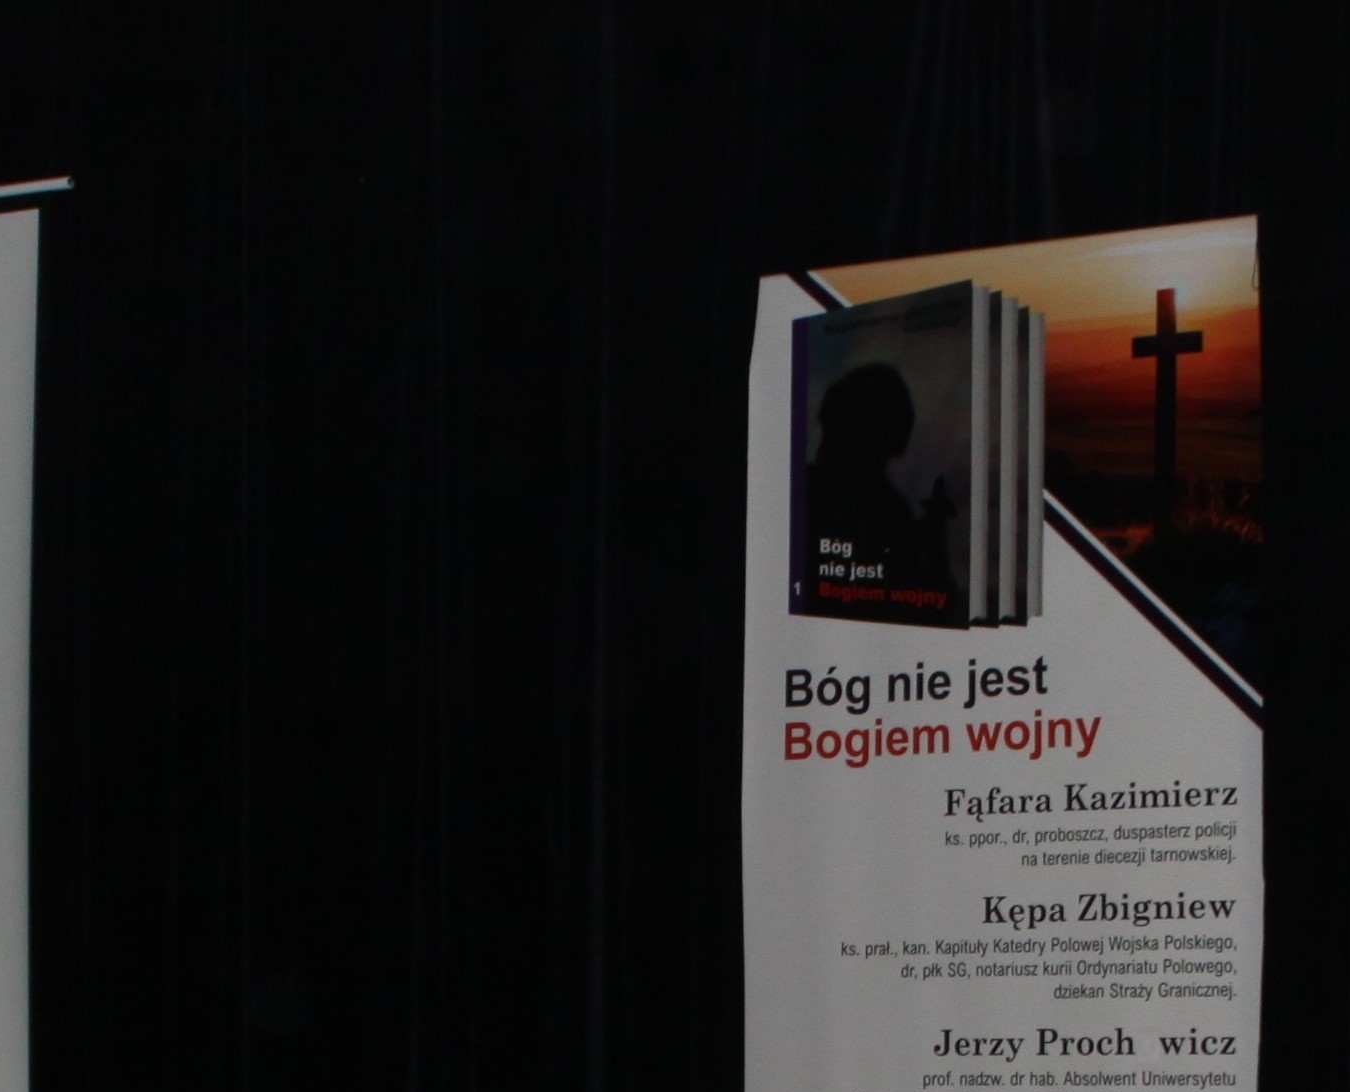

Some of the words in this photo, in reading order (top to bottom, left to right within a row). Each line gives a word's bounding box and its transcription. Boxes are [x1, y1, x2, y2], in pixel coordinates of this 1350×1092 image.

[819, 538, 852, 558] Bóg
[819, 561, 845, 576] nie
[849, 562, 884, 581] jest
[793, 581, 801, 595] 1
[784, 666, 872, 715] Bóg
[887, 662, 951, 702] nie
[964, 656, 1048, 709] jest
[783, 718, 950, 768] Bogiem
[966, 709, 1102, 760] wojny
[943, 787, 1053, 822] Fąfara
[1063, 780, 1238, 812] Kazimierz
[945, 831, 964, 846] ks.
[1034, 828, 1108, 846] proboszcz,
[1114, 825, 1190, 843] duspasterz
[1195, 821, 1236, 840] policji
[1021, 854, 1038, 866] na
[1042, 851, 1090, 865] terenie
[1094, 848, 1146, 867] diecezji
[1150, 846, 1236, 864] tarnowskiej.
[982, 895, 1066, 930] Kępa
[1078, 891, 1237, 927] Zbigniew
[841, 942, 860, 956] ks.
[903, 941, 930, 955] kan.
[935, 939, 988, 957] Kapituły
[993, 939, 1046, 956] Katedry
[1051, 937, 1104, 955] Polowej
[1109, 936, 1159, 954] Wojska
[1164, 935, 1237, 953] Polskiego,
[922, 964, 942, 981] płk
[948, 963, 971, 979] SG,
[976, 962, 1038, 977] notariusz
[1043, 961, 1072, 975] kurii
[1077, 960, 1157, 978] Ordynariatu
[1163, 959, 1237, 977] Polowego,
[1054, 984, 1104, 999] dziekan
[1110, 983, 1152, 1001] Straży
[1158, 982, 1237, 1000] Granicznej.
[933, 1029, 1024, 1062] Jerzy
[1036, 1028, 1136, 1056] Proch
[1159, 1028, 1237, 1056] wicz
[923, 1071, 954, 1090] prof.
[959, 1072, 1004, 1086] nadzw.
[1010, 1072, 1025, 1086] dr
[1030, 1072, 1058, 1086] hab.
[1063, 1071, 1136, 1086] Absolwent
[1142, 1072, 1236, 1090] Uniwersytetu
